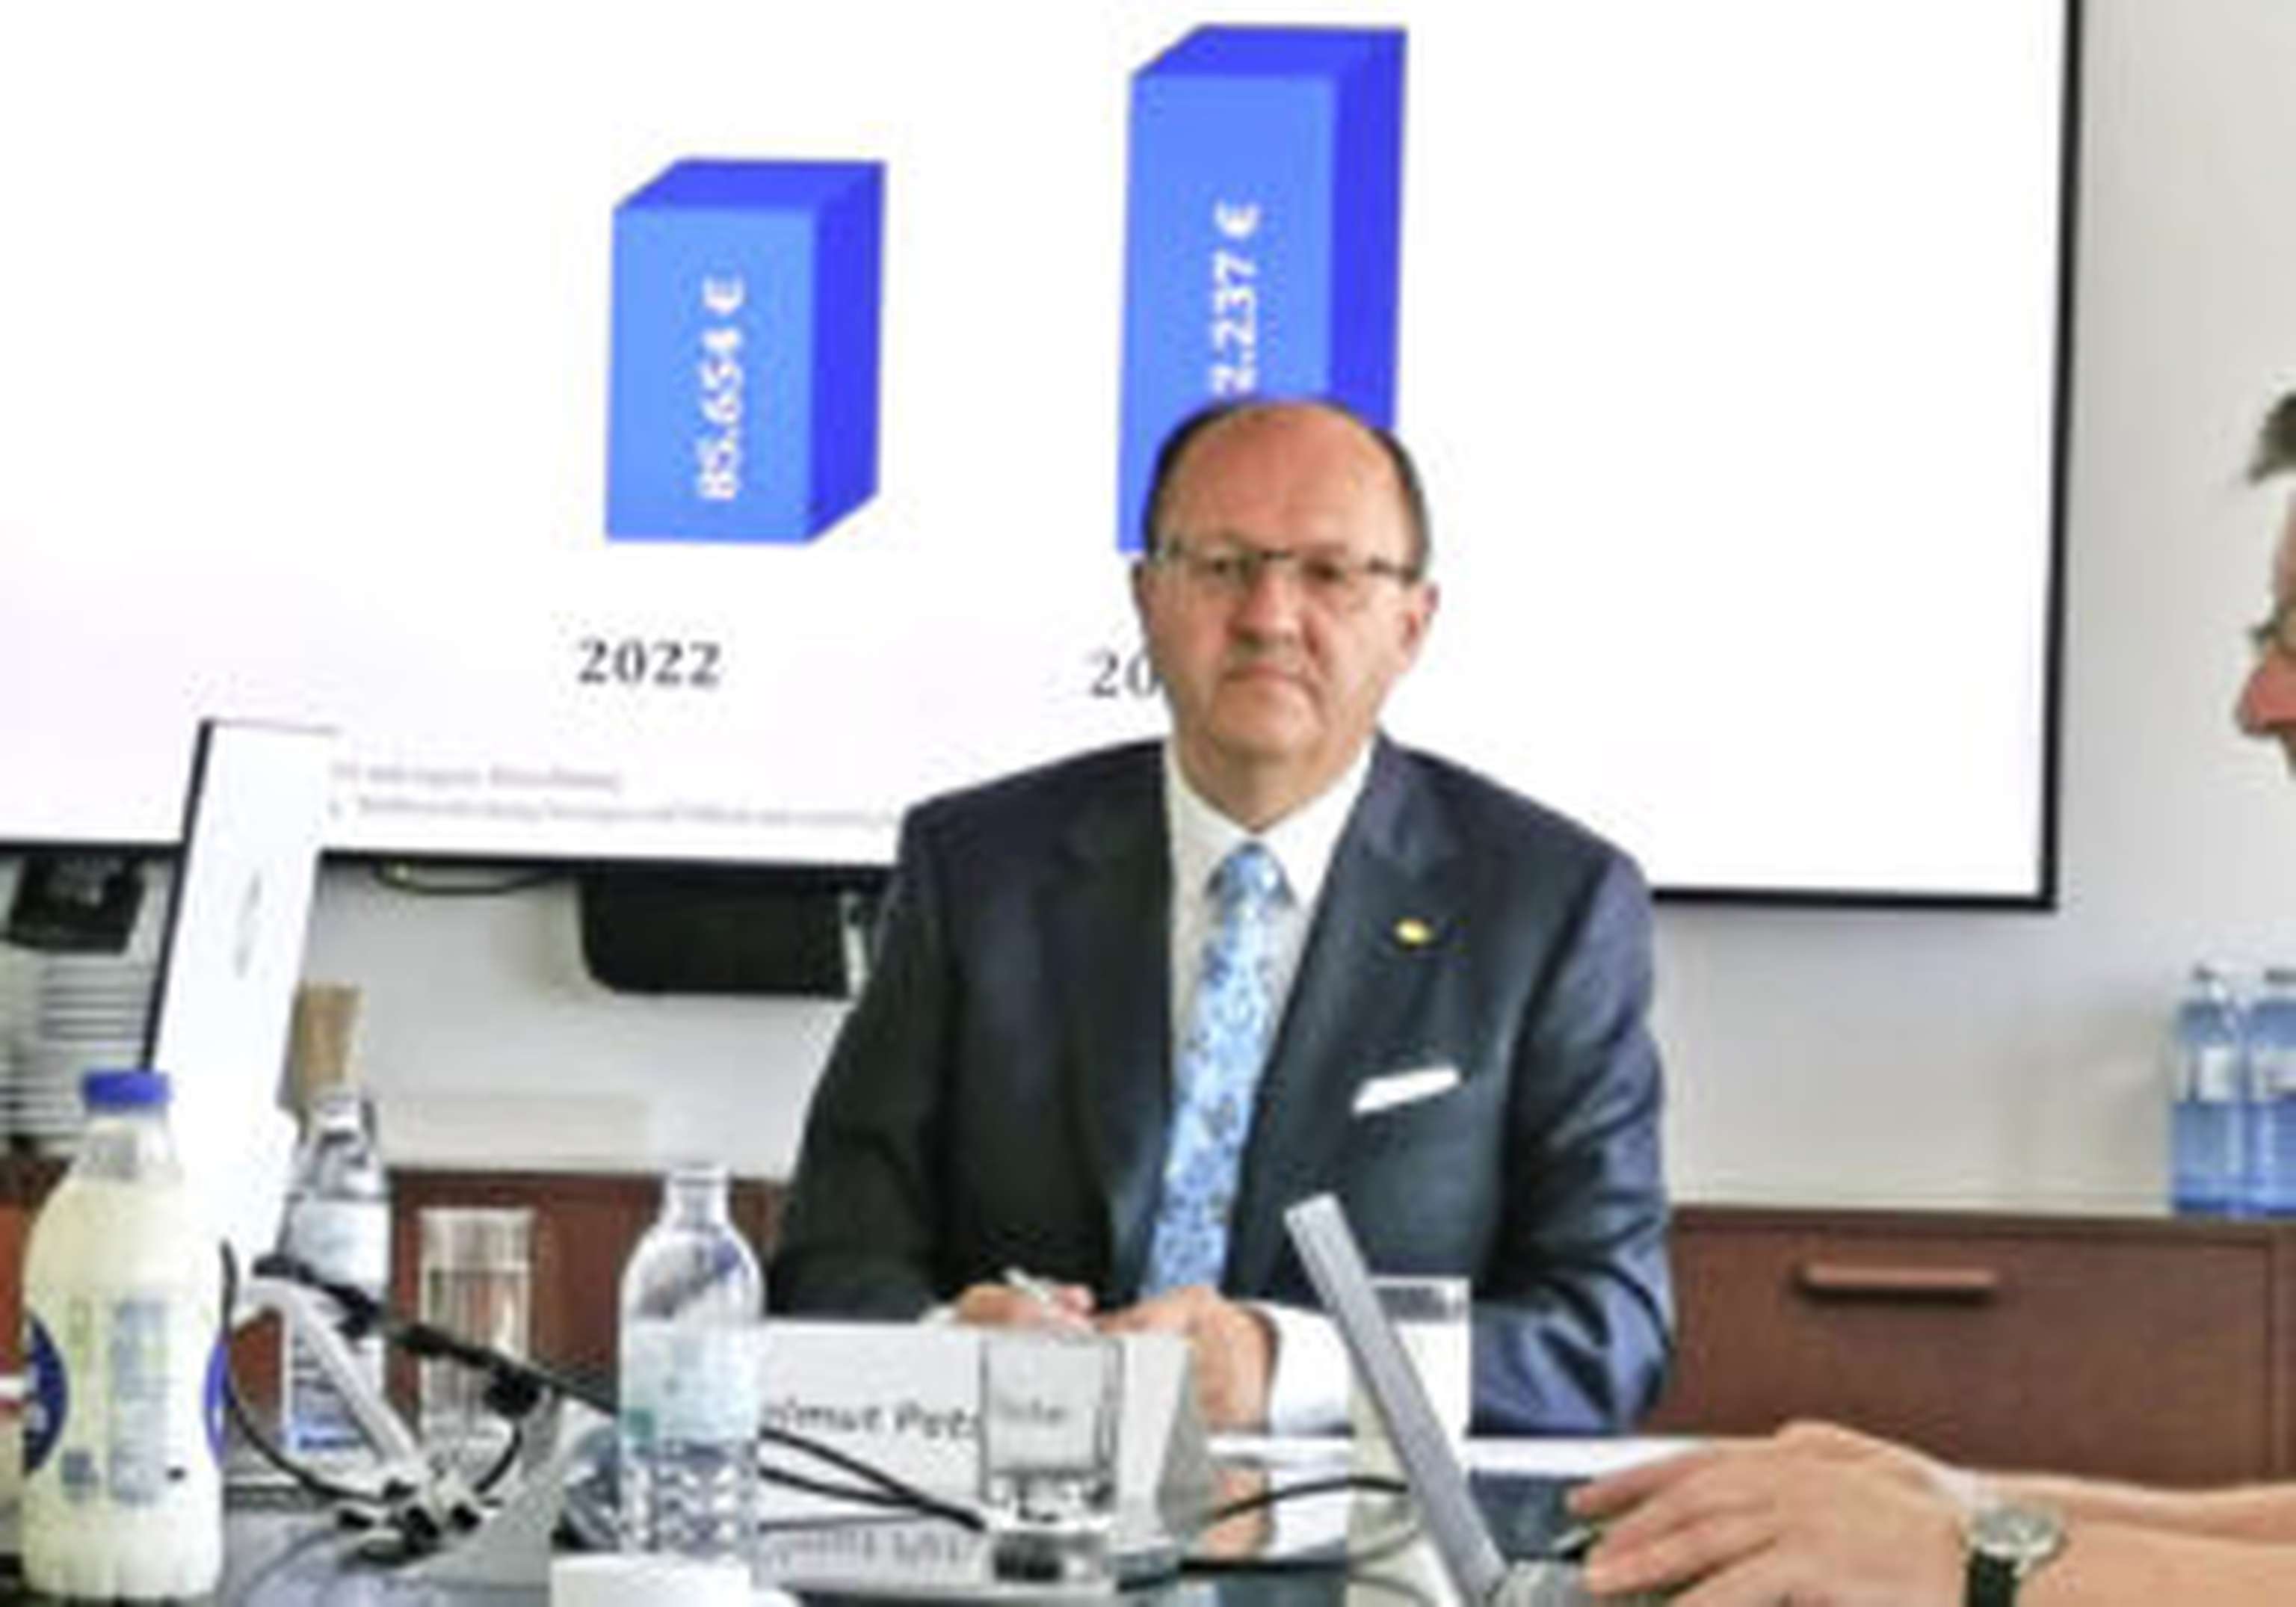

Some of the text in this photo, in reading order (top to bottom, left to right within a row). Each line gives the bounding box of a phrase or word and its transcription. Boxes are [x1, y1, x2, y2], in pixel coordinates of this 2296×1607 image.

[701, 275, 744, 315] €
[1210, 202, 1262, 395] 2.237 €
[577, 637, 720, 686] 2022
[1087, 649, 1160, 697] 20
